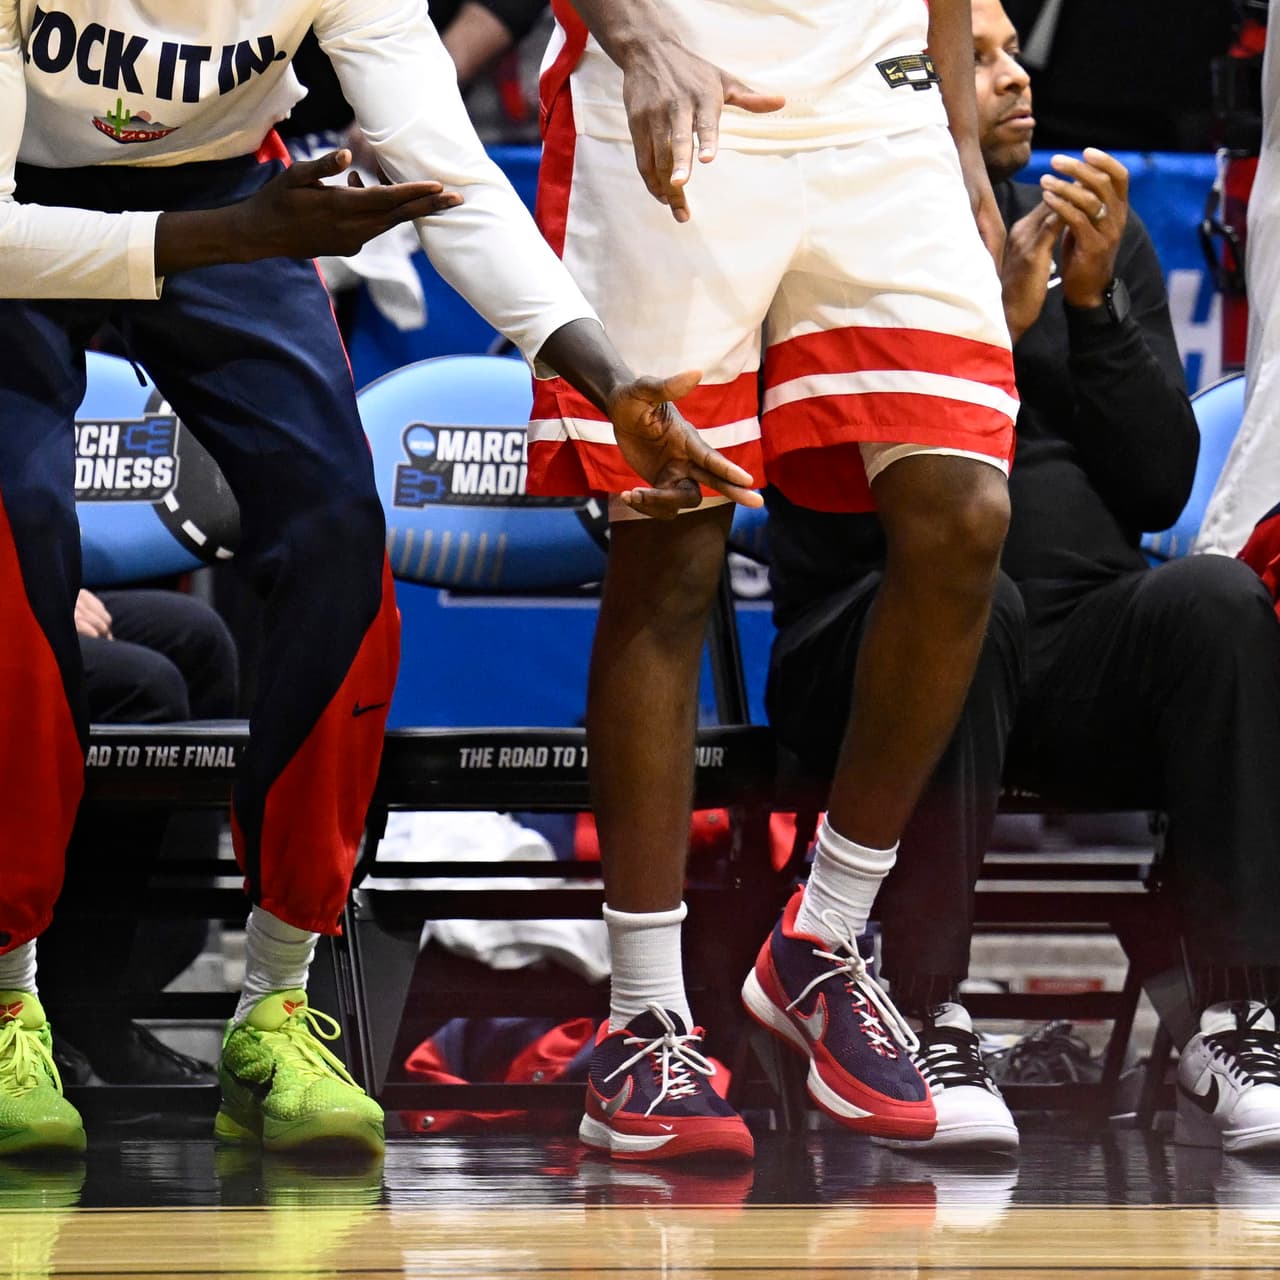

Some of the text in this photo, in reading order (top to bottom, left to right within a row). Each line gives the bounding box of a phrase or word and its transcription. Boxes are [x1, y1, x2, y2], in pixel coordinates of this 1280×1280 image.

[156, 41, 212, 104] IT
[75, 456, 174, 489] DNESS
[86, 745, 237, 769] AD TO THE FINAL
[459, 747, 494, 769] THE
[498, 746, 548, 769] ROAD
[553, 746, 577, 768] TO
